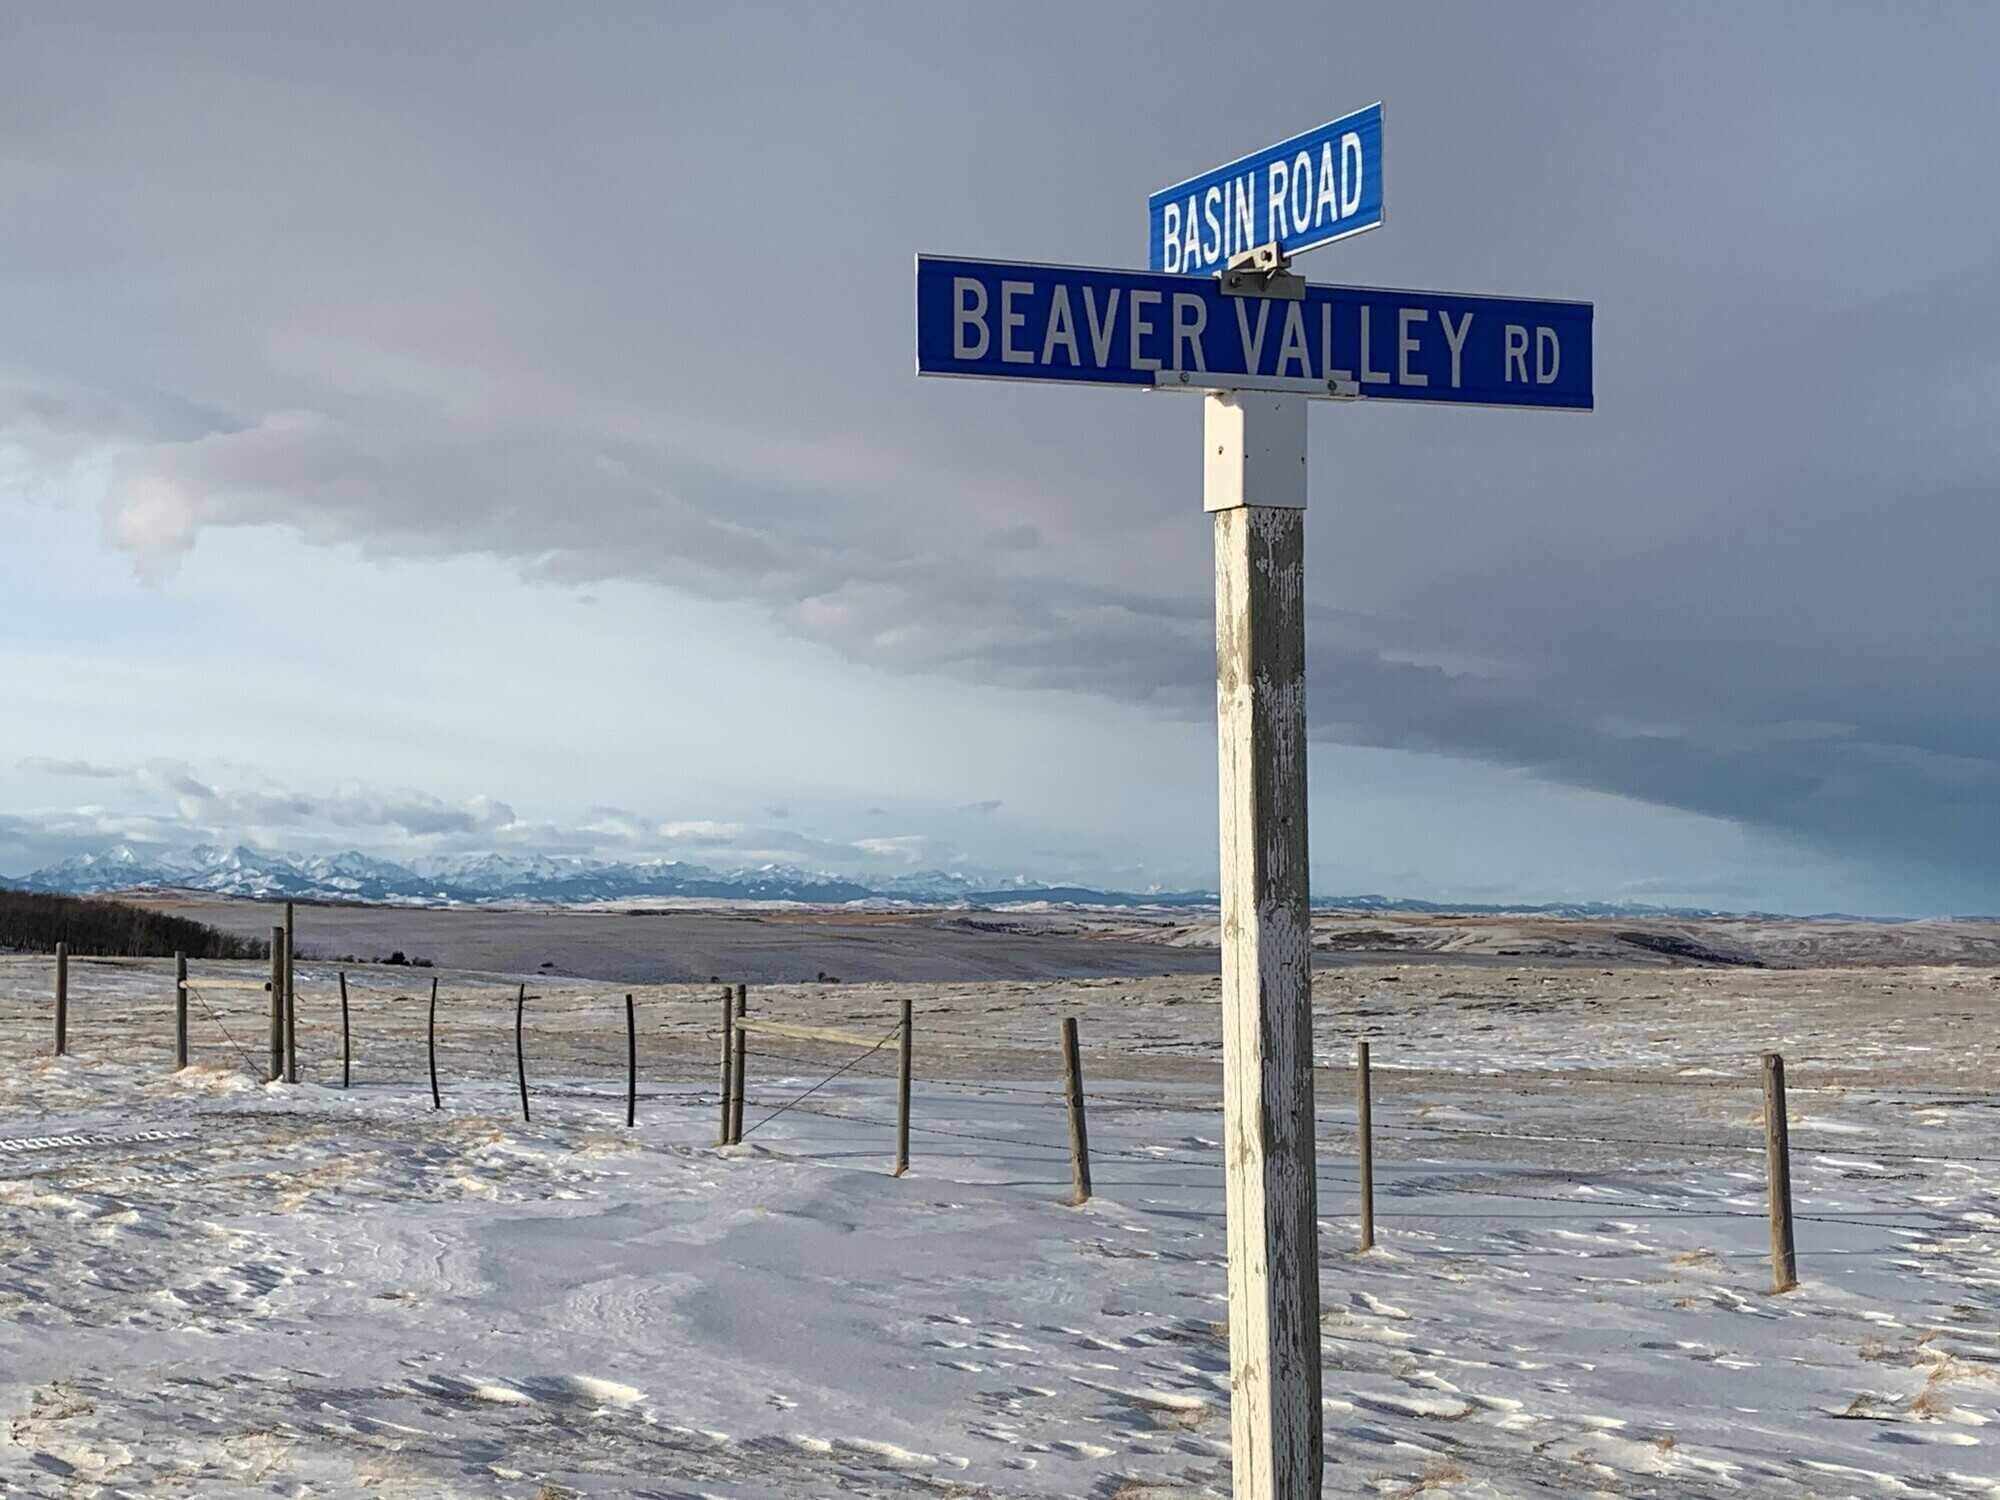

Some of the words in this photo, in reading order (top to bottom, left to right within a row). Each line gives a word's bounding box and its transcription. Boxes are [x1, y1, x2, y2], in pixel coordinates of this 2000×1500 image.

[1164, 172, 1256, 274] BASIN
[1268, 131, 1362, 240] ROAD
[954, 277, 1207, 371] BEAVER
[1235, 297, 1473, 388] VALLEY
[1505, 325, 1560, 384] RD
